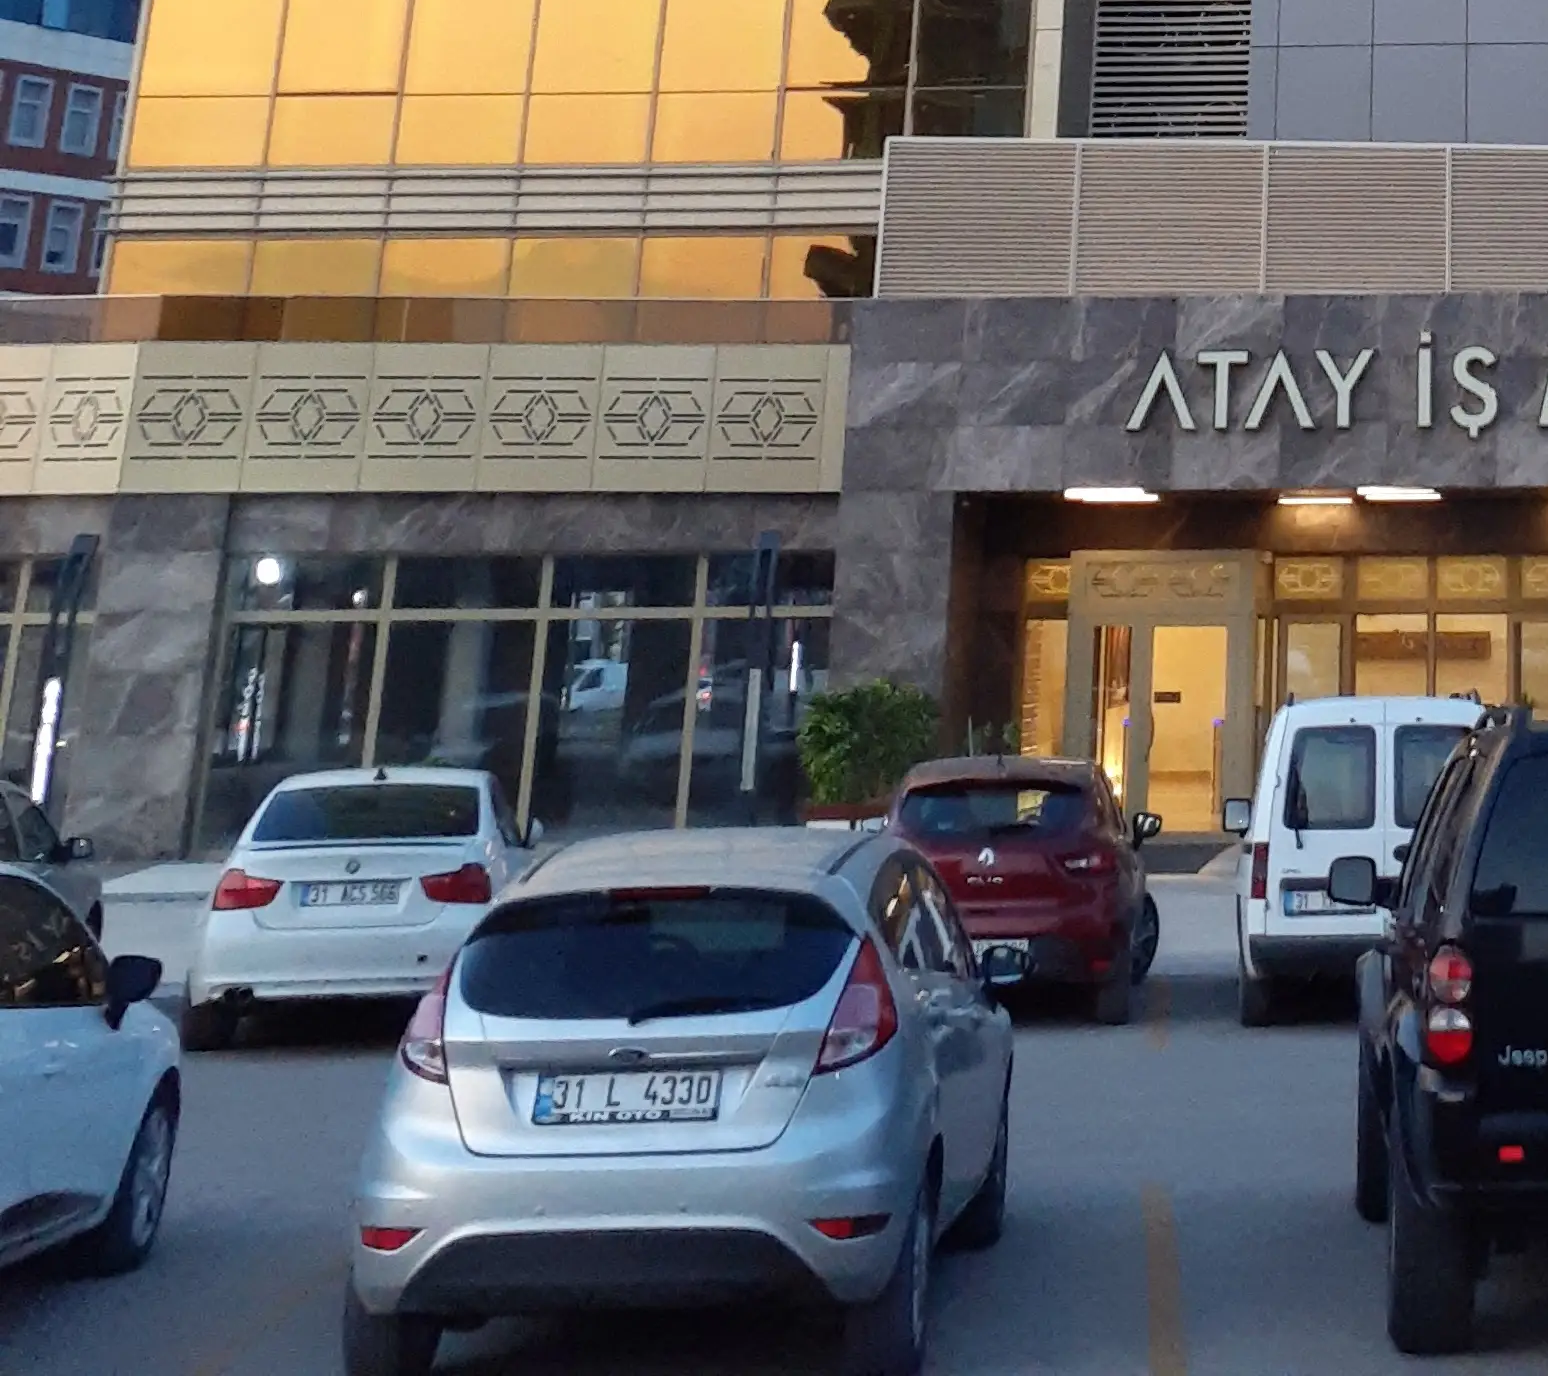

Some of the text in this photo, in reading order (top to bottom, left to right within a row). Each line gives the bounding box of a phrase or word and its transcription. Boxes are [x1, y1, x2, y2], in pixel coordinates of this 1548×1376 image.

[1125, 347, 1375, 431] ATAY
[1416, 328, 1499, 438] İŞ
[311, 885, 328, 903] 31
[1498, 1044, 1548, 1073] Jeep
[553, 1075, 712, 1110] 31 L 4330
